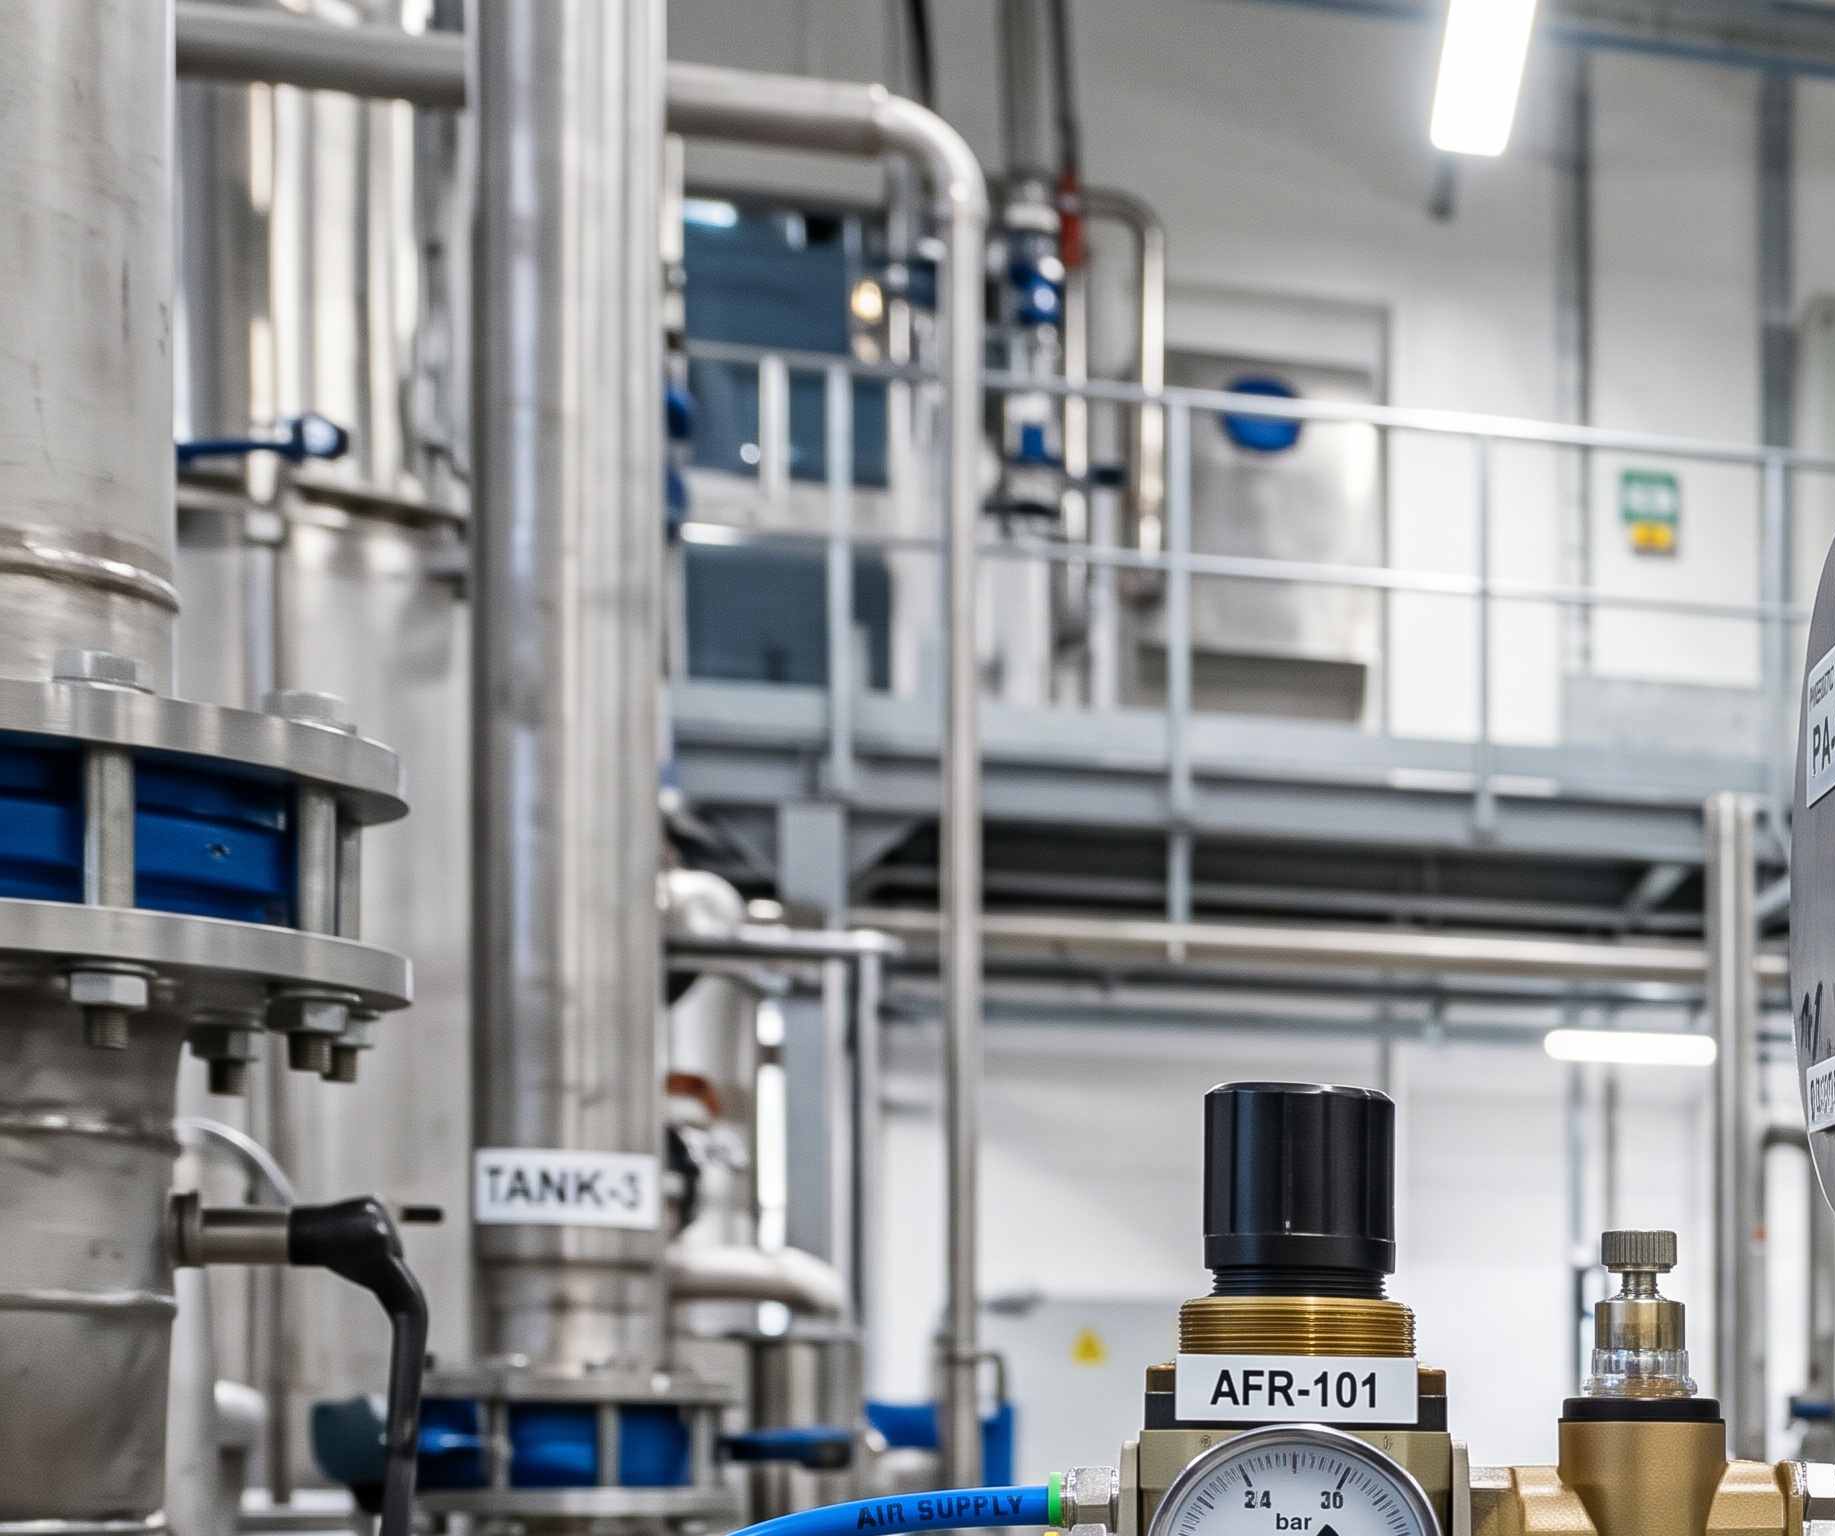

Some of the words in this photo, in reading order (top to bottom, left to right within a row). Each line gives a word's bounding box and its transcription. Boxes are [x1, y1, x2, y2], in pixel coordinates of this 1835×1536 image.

[486, 1165, 641, 1211] TANK-3
[1210, 1369, 1376, 1409] AFR-101
[857, 1502, 906, 1530] AIR
[917, 1495, 1023, 1521] SUPPLY
[1276, 1513, 1313, 1531] bar
